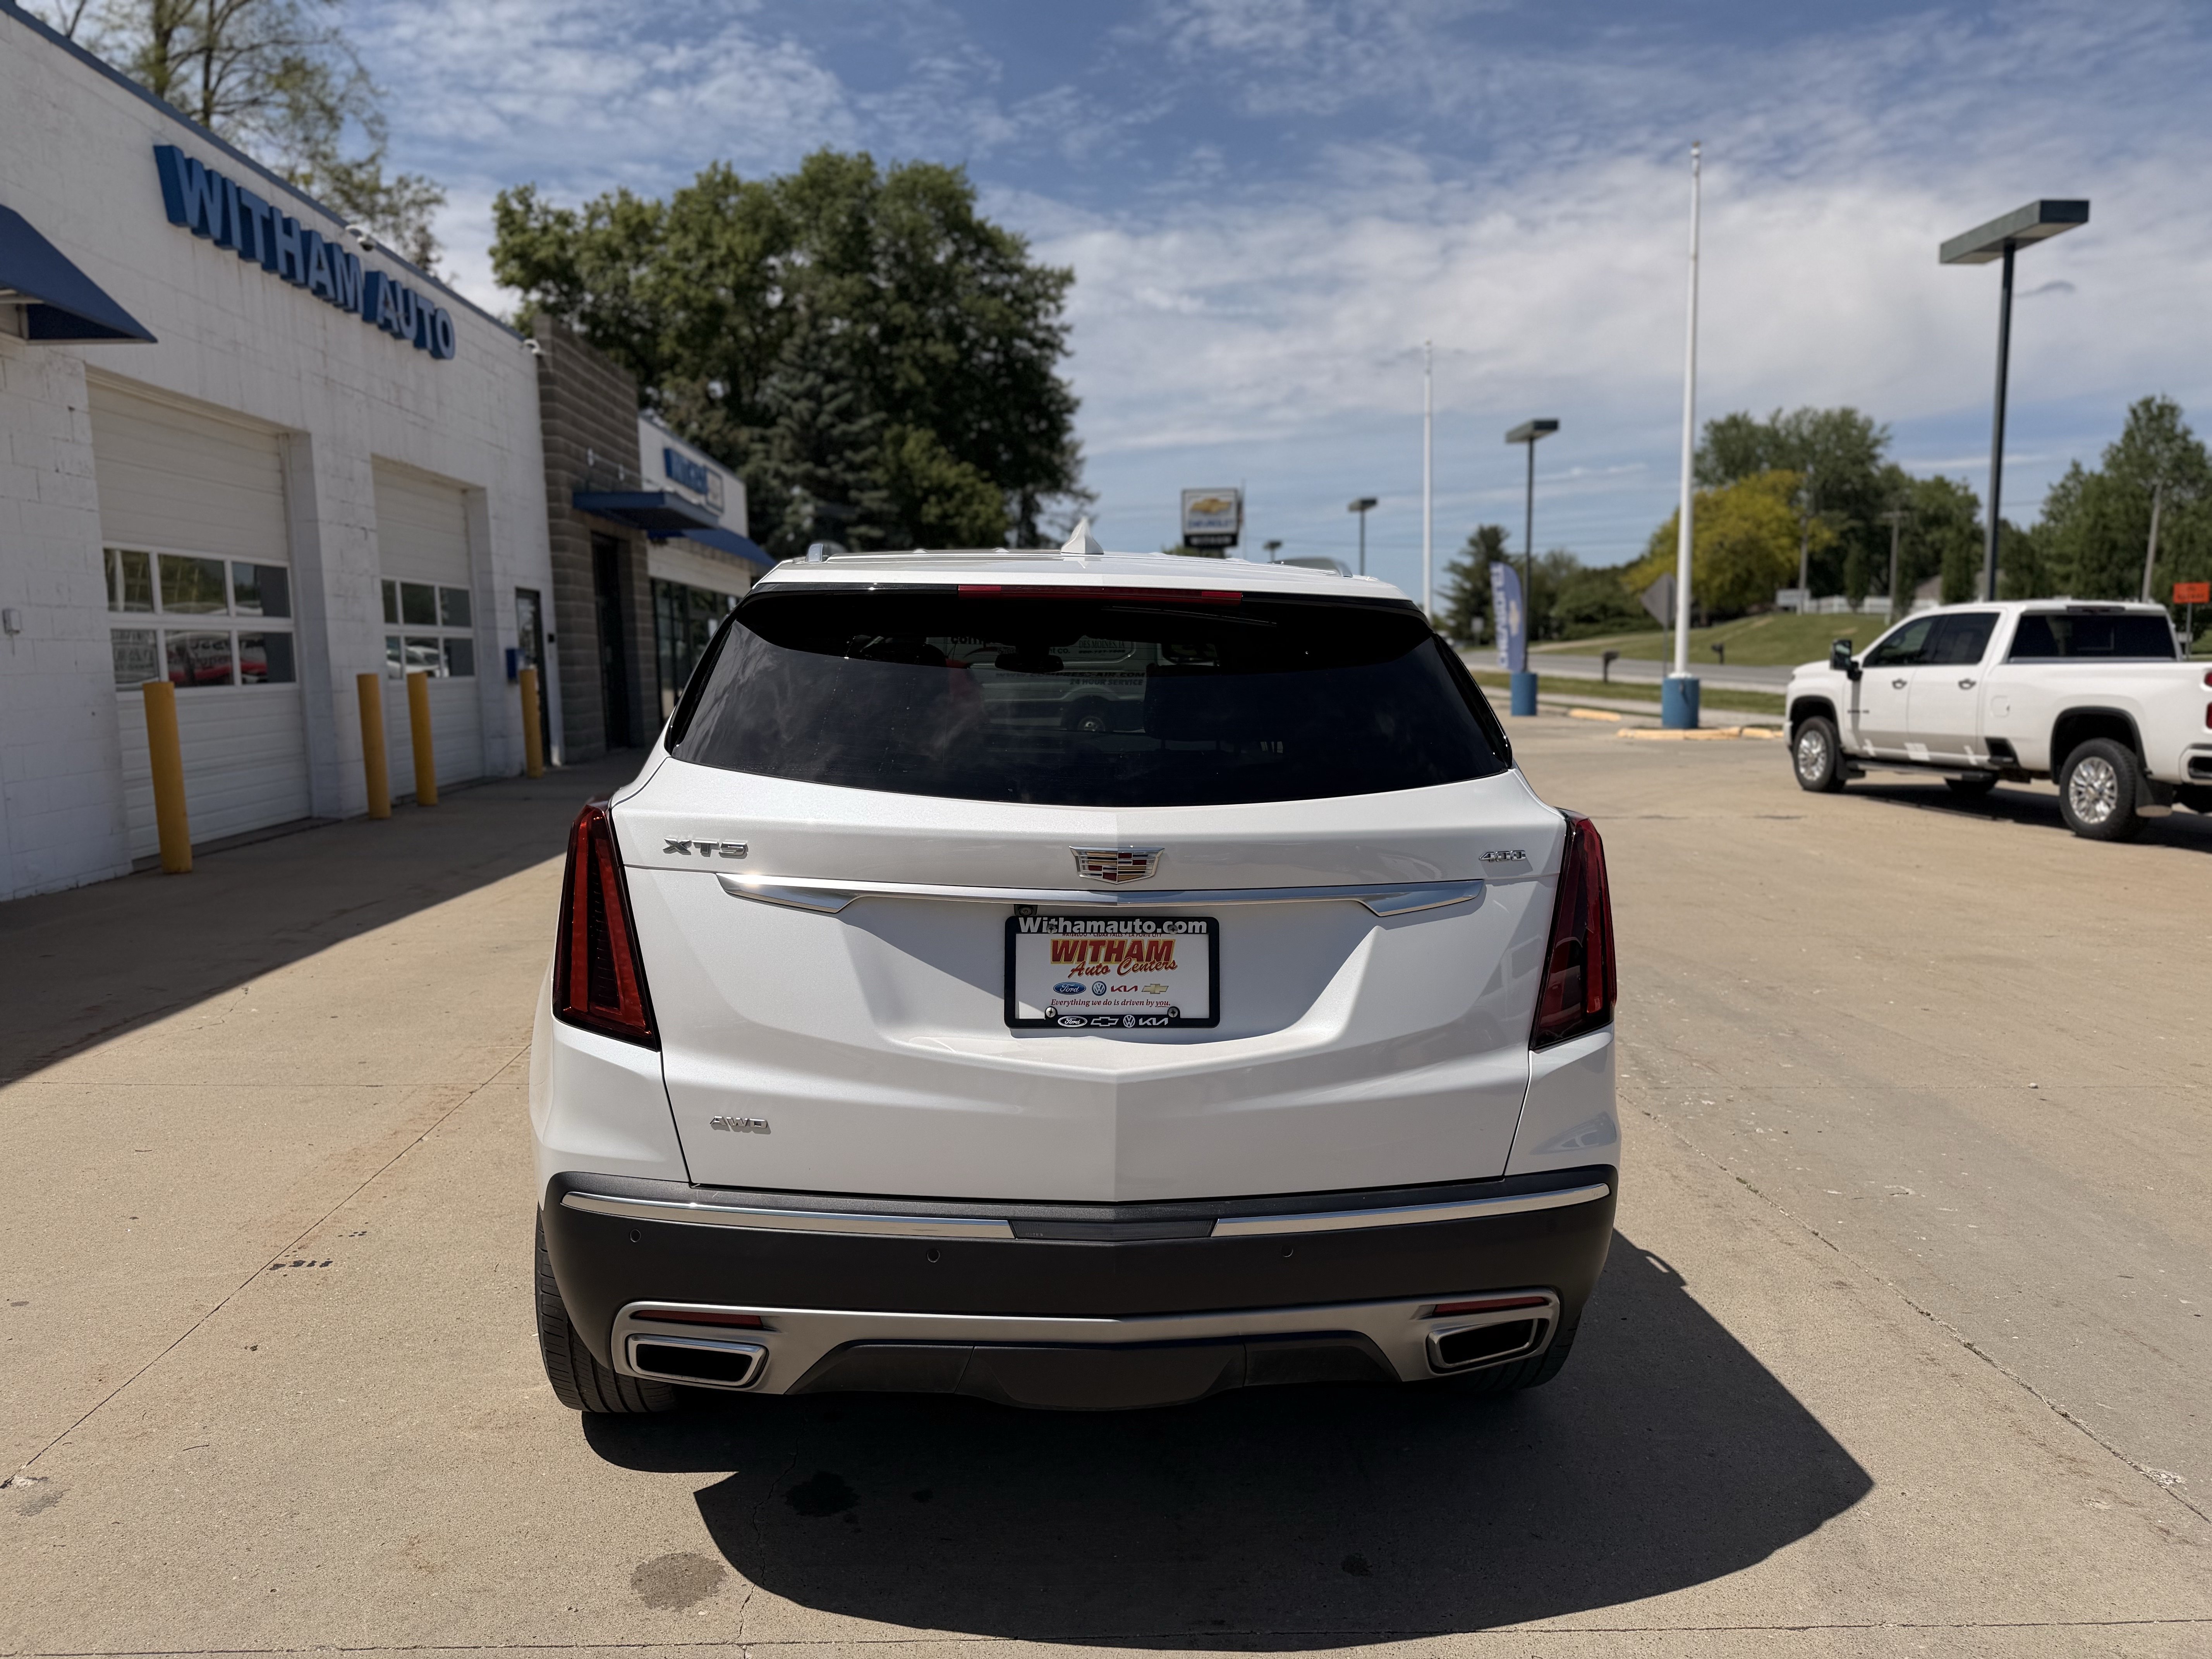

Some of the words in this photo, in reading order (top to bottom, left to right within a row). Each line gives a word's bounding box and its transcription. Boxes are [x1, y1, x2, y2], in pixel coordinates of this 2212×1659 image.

[153, 145, 364, 314] WITHAM
[362, 271, 455, 360] AUTO
[663, 838, 748, 859] XT5
[1019, 917, 1207, 933] Withamauto.com
[1051, 939, 1175, 964] WITHAM
[1068, 960, 1111, 979] Auto
[1117, 957, 1178, 976] Centers
[709, 1115, 769, 1129] AWD
